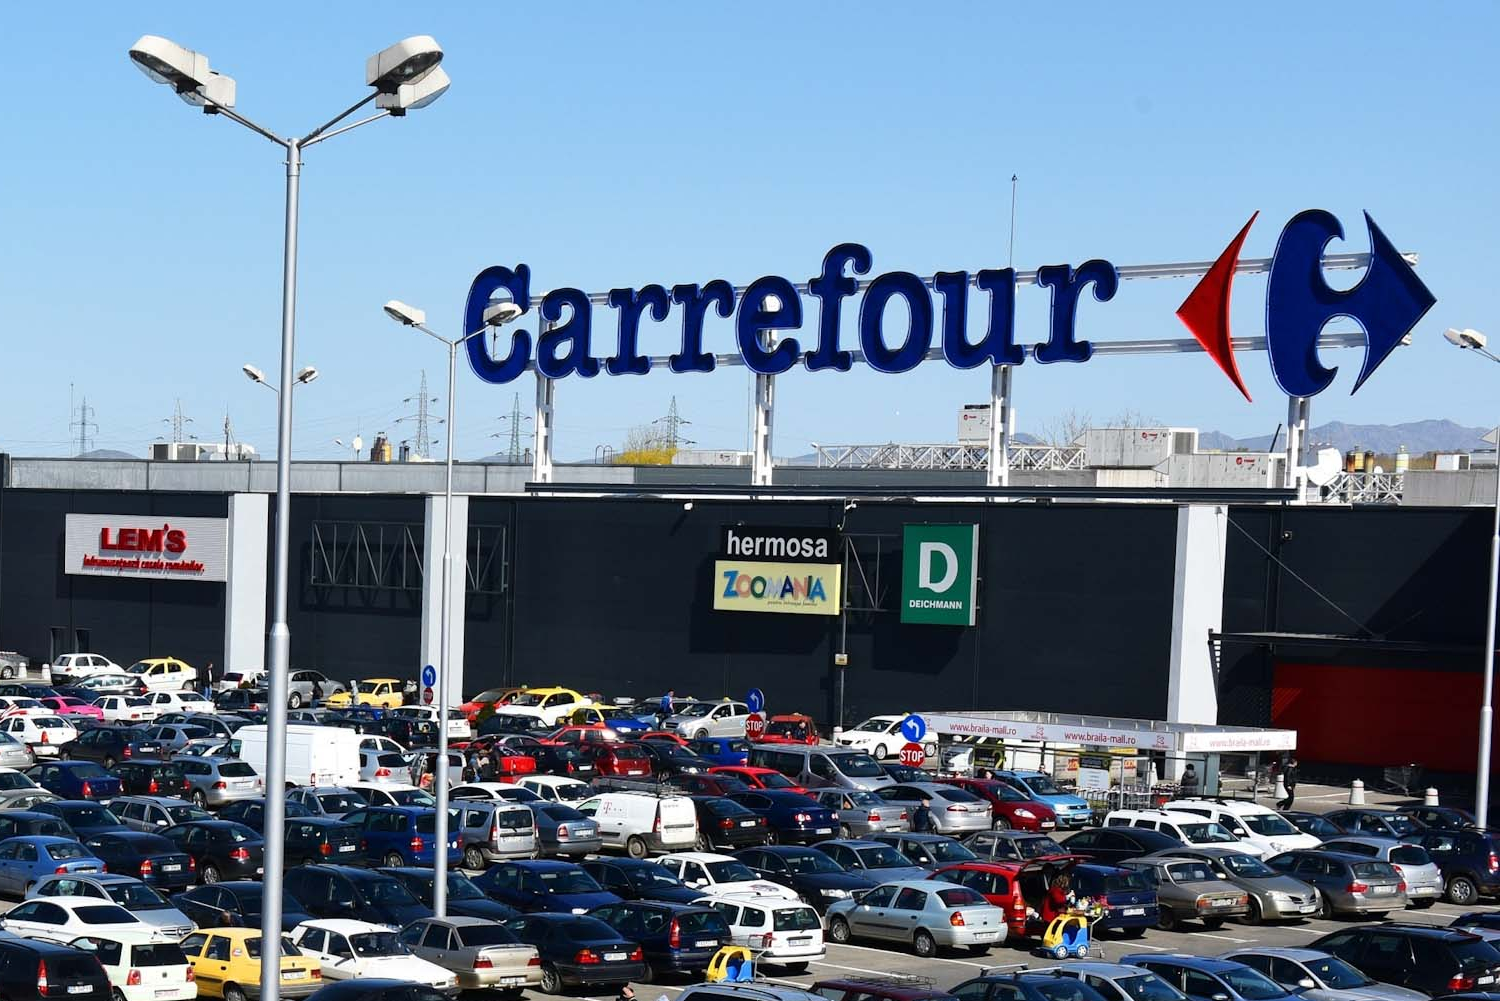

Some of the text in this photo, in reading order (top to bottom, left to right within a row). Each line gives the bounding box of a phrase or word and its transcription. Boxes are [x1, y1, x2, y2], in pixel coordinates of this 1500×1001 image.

[465, 242, 1119, 385] Carrefour
[727, 530, 828, 558] hermosa
[919, 542, 959, 593] D
[723, 570, 827, 601] ZOOMANIA
[909, 600, 963, 610] DEICHMANN
[746, 720, 763, 730] STOP
[950, 723, 1017, 735] www.braila-mall.ro
[1064, 732, 1136, 745] www.braila-mall.ro
[900, 751, 923, 763] STOP
